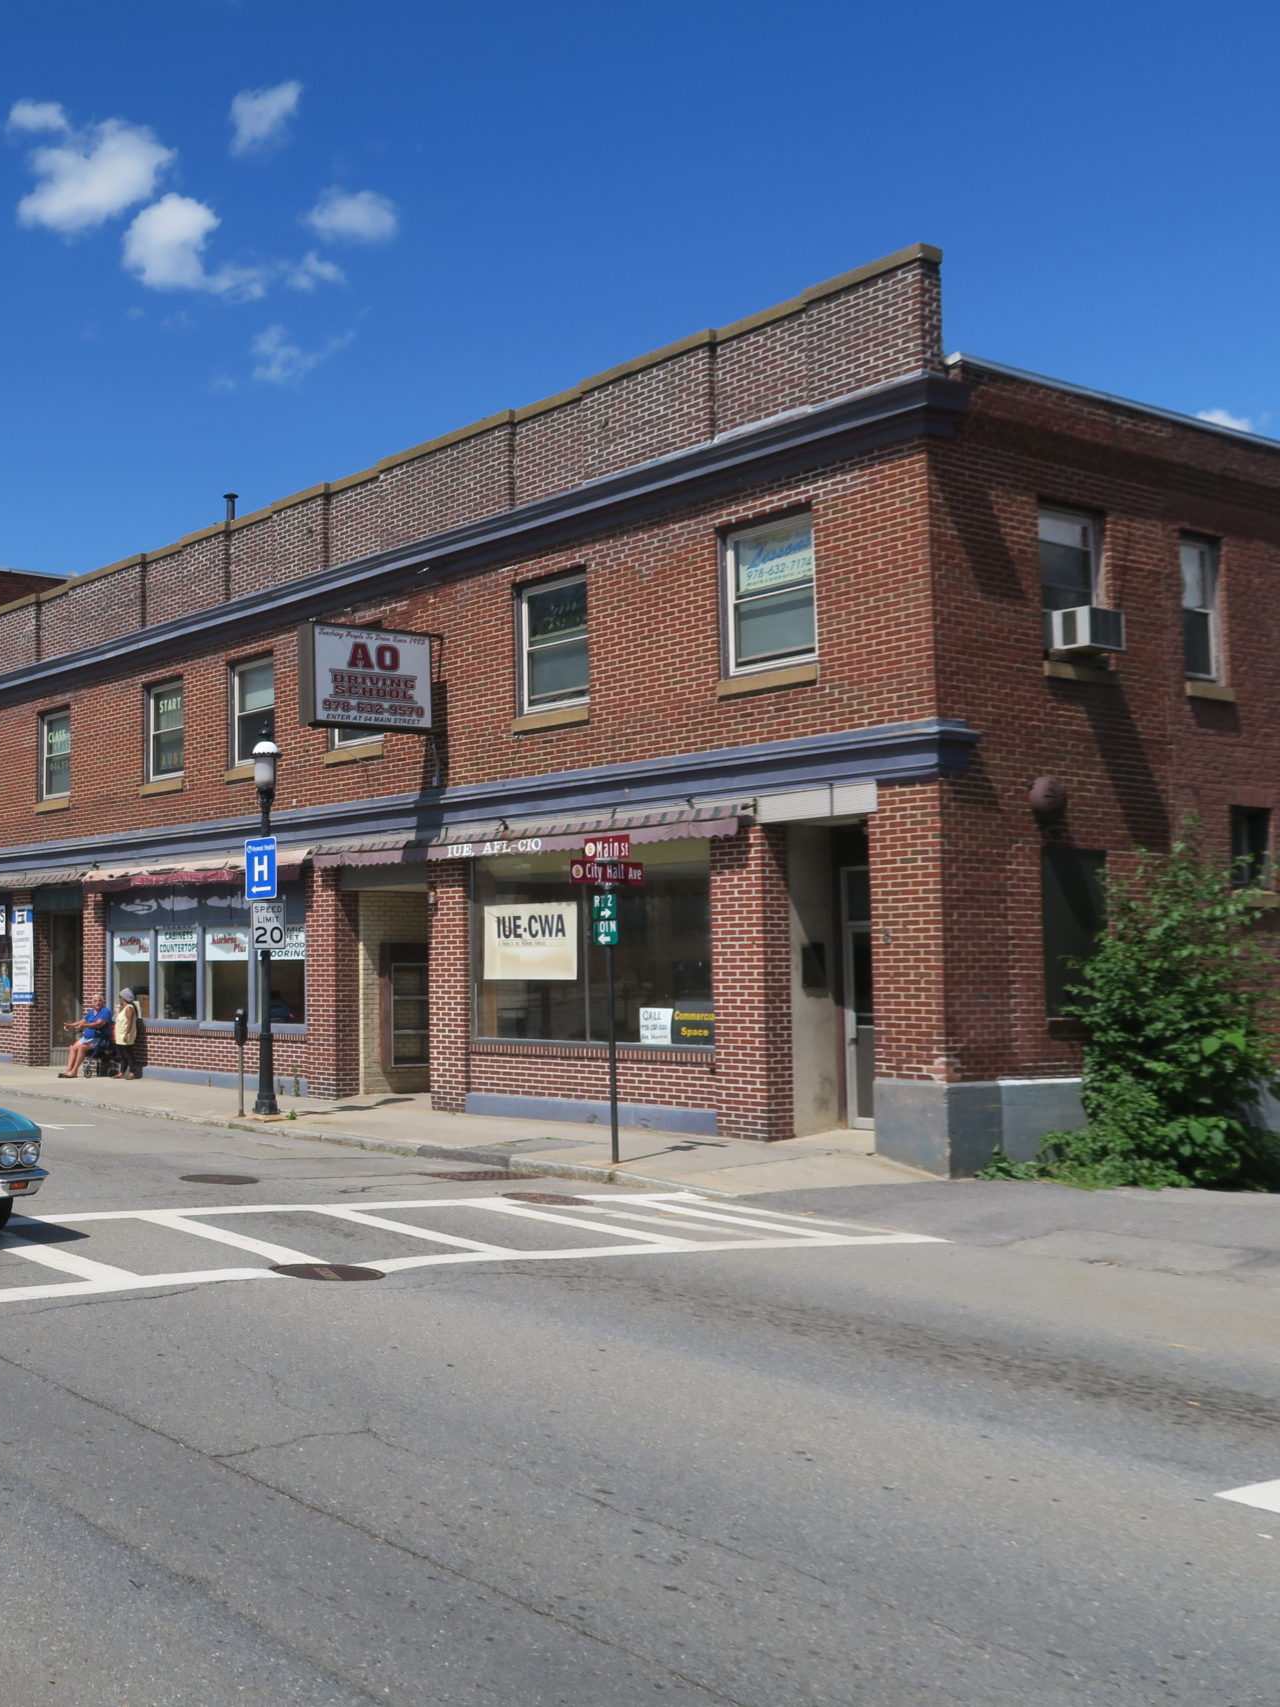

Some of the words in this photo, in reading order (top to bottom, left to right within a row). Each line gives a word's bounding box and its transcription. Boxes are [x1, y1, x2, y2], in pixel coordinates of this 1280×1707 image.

[746, 557, 812, 580] 978-632-7174
[319, 627, 344, 640] Teaching
[346, 631, 364, 641] People
[347, 641, 400, 671] AO
[331, 672, 416, 690] DRIVING
[333, 684, 415, 701] SCHOOL
[159, 696, 182, 713] START
[322, 698, 425, 718] 978-632-9570
[326, 713, 351, 721] ENTER
[393, 717, 422, 725] STREET
[48, 729, 66, 743] CLASS
[447, 843, 475, 858] IUE,
[482, 838, 542, 855] AFL-CIO
[596, 838, 619, 858] Main
[254, 855, 268, 882] H
[585, 862, 603, 883] City
[606, 863, 625, 879] Hall
[628, 867, 642, 880] Ave
[593, 895, 606, 907] RT
[607, 894, 613, 906] 2
[254, 905, 283, 914] SPEED
[257, 916, 280, 924] LIMIT
[164, 930, 194, 941] CABINETS
[254, 926, 284, 944] 20
[642, 1010, 662, 1021] CALL
[674, 1010, 716, 1021] Commercia
[681, 1026, 710, 1037] Space
